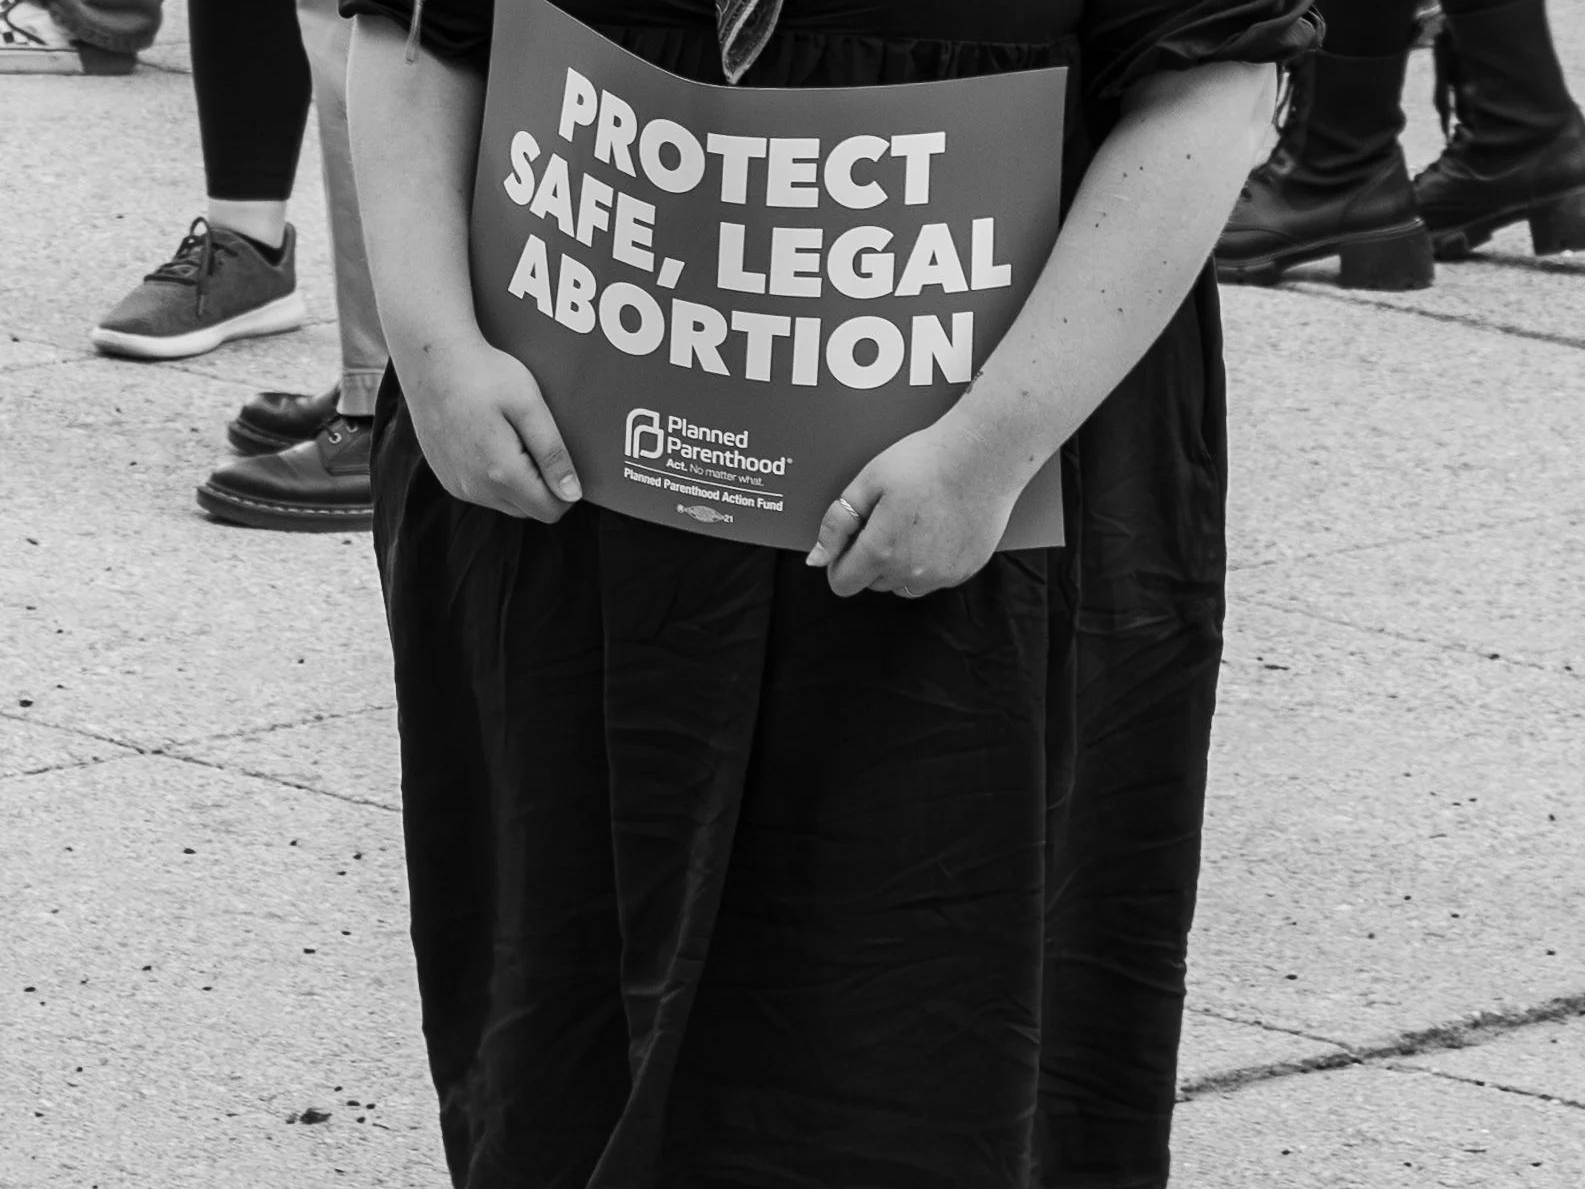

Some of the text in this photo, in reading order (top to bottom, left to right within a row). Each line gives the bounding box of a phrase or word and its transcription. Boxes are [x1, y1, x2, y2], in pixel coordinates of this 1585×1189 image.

[558, 66, 945, 209] PROTECT
[503, 130, 1012, 299] SAFE, LEGAL
[507, 234, 974, 389] ABORTION
[665, 458, 765, 487] Act. No matter what.
[667, 415, 749, 449] Planned
[623, 467, 783, 512] Planned Parenthood Action Fund
